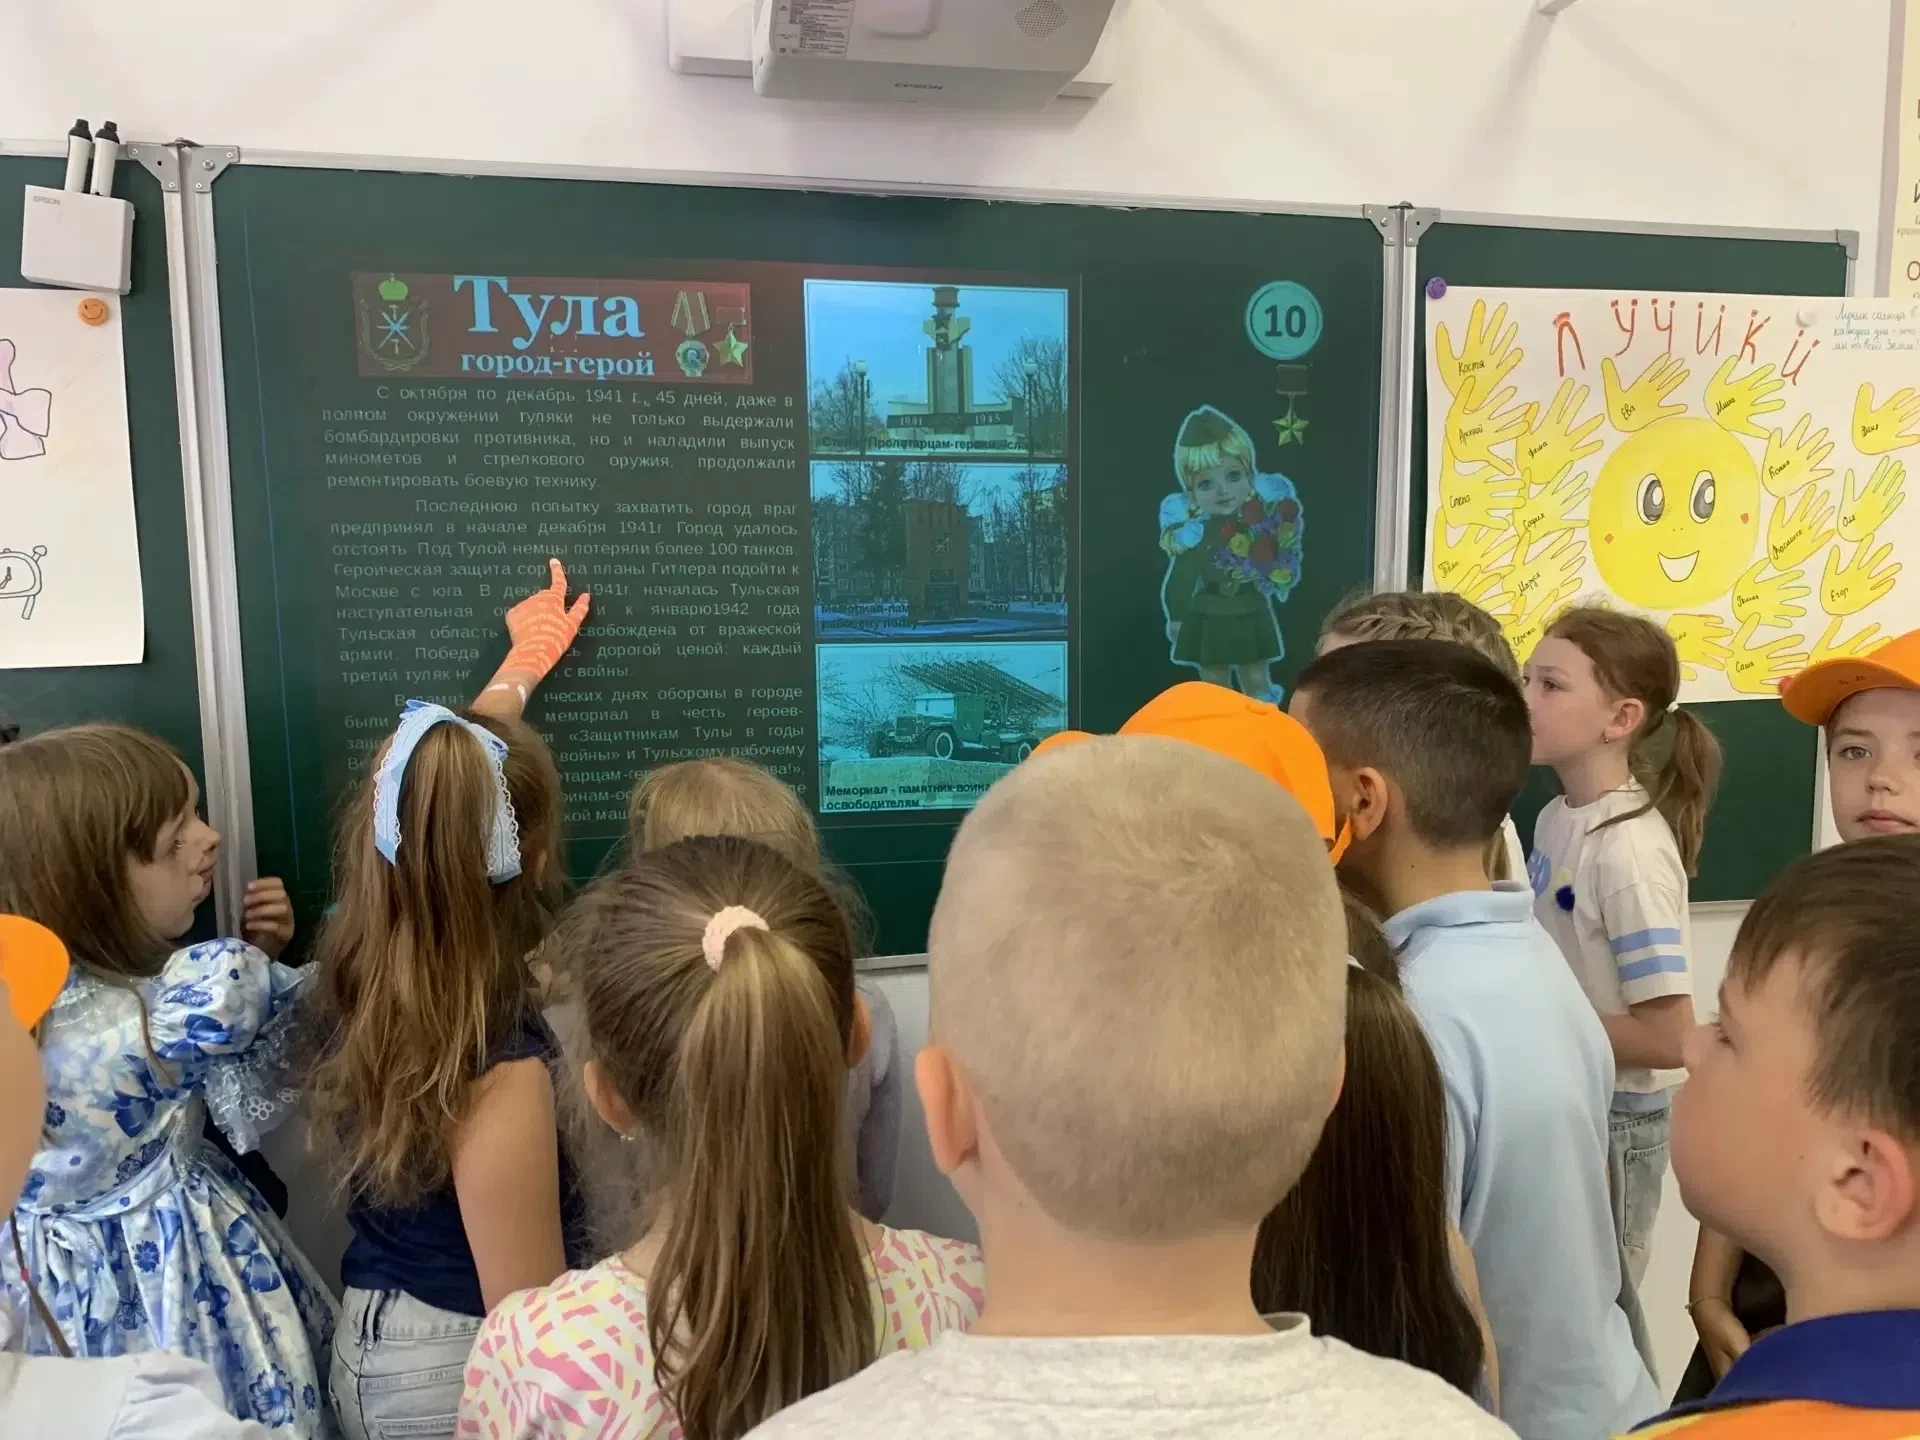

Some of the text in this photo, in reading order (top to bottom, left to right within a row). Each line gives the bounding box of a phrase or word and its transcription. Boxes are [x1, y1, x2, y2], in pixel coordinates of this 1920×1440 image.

[893, 82, 944, 91] EPSON
[33, 195, 60, 206] EPSON
[453, 275, 645, 350] Тула
[1264, 305, 1306, 338] 10
[460, 350, 655, 379] город-герой
[1458, 360, 1485, 376] Костя
[376, 386, 391, 399] С
[400, 386, 467, 402] октября
[477, 388, 496, 400] по
[506, 386, 575, 404] декабрь
[586, 389, 623, 403] 1941
[656, 390, 676, 404] 45
[684, 392, 728, 407] дней,
[736, 394, 776, 408] даже
[785, 396, 793, 407] в
[322, 409, 794, 430] полном окружении туляки не только выдержали
[1620, 403, 1636, 420] Ева
[324, 429, 795, 452] бомбардировки противника, но и наладили выпуск
[325, 453, 422, 465] минометов
[447, 453, 457, 464] и
[483, 454, 585, 468] стрелкового
[698, 457, 796, 472] продолжали
[327, 474, 459, 489] ремонтировать
[465, 473, 528, 489] боевую
[416, 500, 796, 517] Последнюю попытку захватить город враг
[331, 522, 433, 536] предпринял
[446, 523, 455, 533] в
[467, 522, 527, 533] начале
[538, 520, 606, 536] декабря
[677, 521, 723, 536] Город
[735, 523, 798, 537] удалось
[417, 542, 452, 558] Под
[457, 541, 507, 557] Тулой
[513, 544, 568, 557] немцы
[574, 543, 650, 557] потеряли
[655, 542, 704, 556] более
[709, 543, 737, 556] 100
[334, 562, 799, 578] Героическая защита сорла планы Гитлера подойти к
[336, 585, 399, 598] Москве
[410, 586, 420, 597] с
[480, 584, 491, 597] В
[644, 585, 718, 596] началась
[730, 583, 800, 598] Тульская
[1830, 588, 1849, 603] Егор
[336, 607, 473, 621] наступательная
[597, 606, 606, 616] и
[626, 606, 633, 616] к
[767, 604, 800, 617] года
[339, 622, 801, 641] Тульская область свобождена от вражеской
[339, 651, 398, 663] армии.
[415, 647, 480, 662] Победа
[597, 644, 661, 658] дорогой
[743, 642, 802, 657] каждый
[341, 669, 398, 684] третий
[405, 669, 450, 684] туляк
[563, 668, 573, 677] с
[577, 664, 633, 678] войны.
[1735, 661, 1755, 673] Саша
[395, 694, 405, 706] В
[612, 690, 648, 704] днях
[657, 687, 726, 702] обороны
[735, 689, 743, 698] в
[751, 687, 803, 700] городе
[344, 706, 803, 728] были мемориал в честь героев-
[569, 728, 679, 743] «Защитникам
[694, 726, 732, 740] Тулы
[746, 727, 754, 737] в
[768, 725, 804, 739] годы
[560, 743, 805, 762] войны» и Тульскому рабочему
[826, 785, 887, 796] Мемориал
[899, 783, 952, 795] памятник
[826, 798, 920, 811] освободителям
